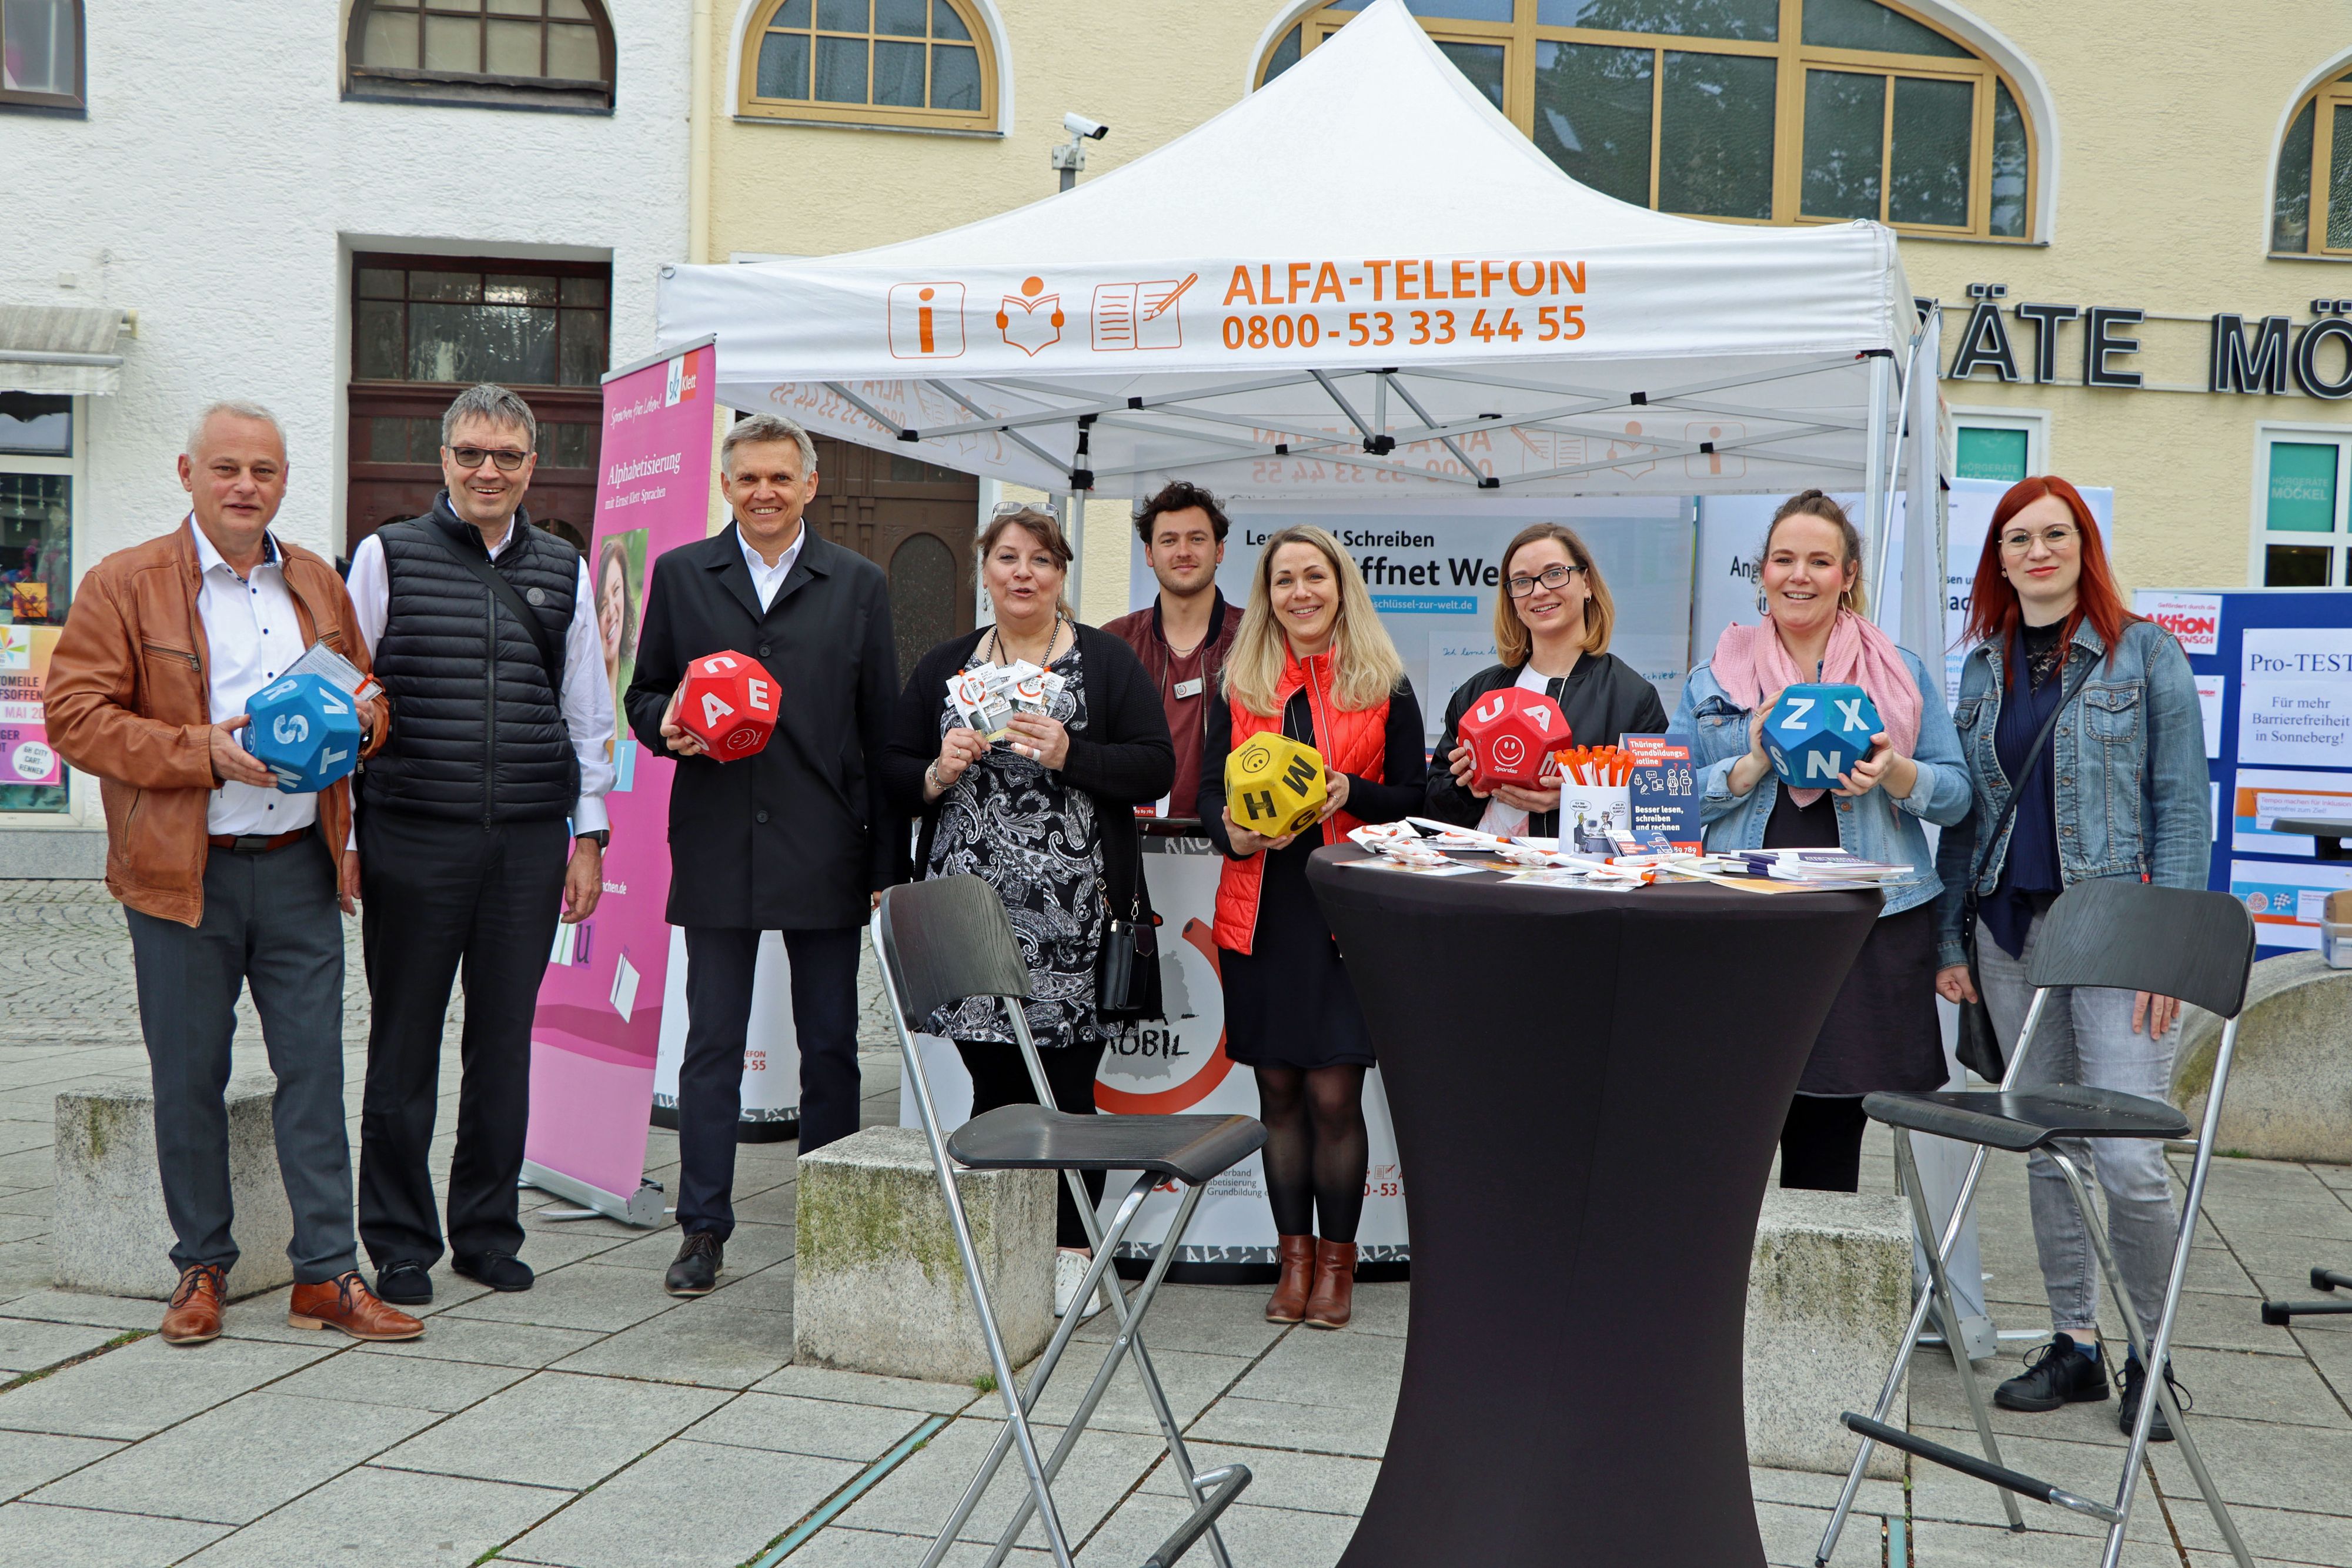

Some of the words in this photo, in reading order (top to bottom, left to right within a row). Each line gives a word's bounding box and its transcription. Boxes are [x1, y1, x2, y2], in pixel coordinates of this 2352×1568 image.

[1222, 259, 1586, 306] ALFA-TELEFON
[1409, 310, 1456, 346] 33
[1470, 307, 1523, 343] 44
[1538, 305, 1586, 342] 55
[2209, 298, 2352, 400] MÖ
[681, 374, 697, 392] Klett
[607, 452, 681, 489] Alphabetisierung
[604, 497, 614, 510] mit
[615, 494, 629, 508] Ernst
[629, 492, 640, 506] Klett
[641, 486, 666, 504] Sprachen
[2271, 485, 2328, 500] MÖCKEL
[1343, 529, 1435, 547] Schreiben
[1352, 556, 1441, 586] ffnet
[1448, 557, 1499, 587] We
[2250, 653, 2352, 672] Pro-TEST
[262, 678, 298, 702] R
[748, 677, 770, 711] E
[2271, 696, 2293, 708] Für
[2297, 697, 2331, 708] mehr
[5, 706, 27, 718] MAI
[700, 691, 735, 729] A
[1476, 695, 1505, 723] U
[1522, 704, 1552, 733] A
[1780, 697, 1816, 730] Z
[1833, 698, 1870, 732] X
[2251, 713, 2351, 727] Barrierefreiheit
[273, 714, 309, 745] S
[2255, 730, 2267, 741] in
[2270, 730, 2344, 746] Sonneberg!
[1629, 741, 1664, 750] Thüringer
[319, 747, 348, 775] T
[1494, 765, 1519, 774] Spordas
[1769, 745, 1790, 777] S
[1806, 750, 1842, 780] N
[1242, 790, 1278, 821] H
[1635, 805, 1660, 814] Besser
[1661, 805, 1684, 815] lesen,
[2261, 797, 2282, 805] Tempo
[1289, 809, 1317, 832] G
[1635, 814, 1671, 823] schreiben
[1684, 846, 1697, 854] 789
[751, 1059, 766, 1071] 55
[1207, 1187, 1262, 1198] Grundbildung
